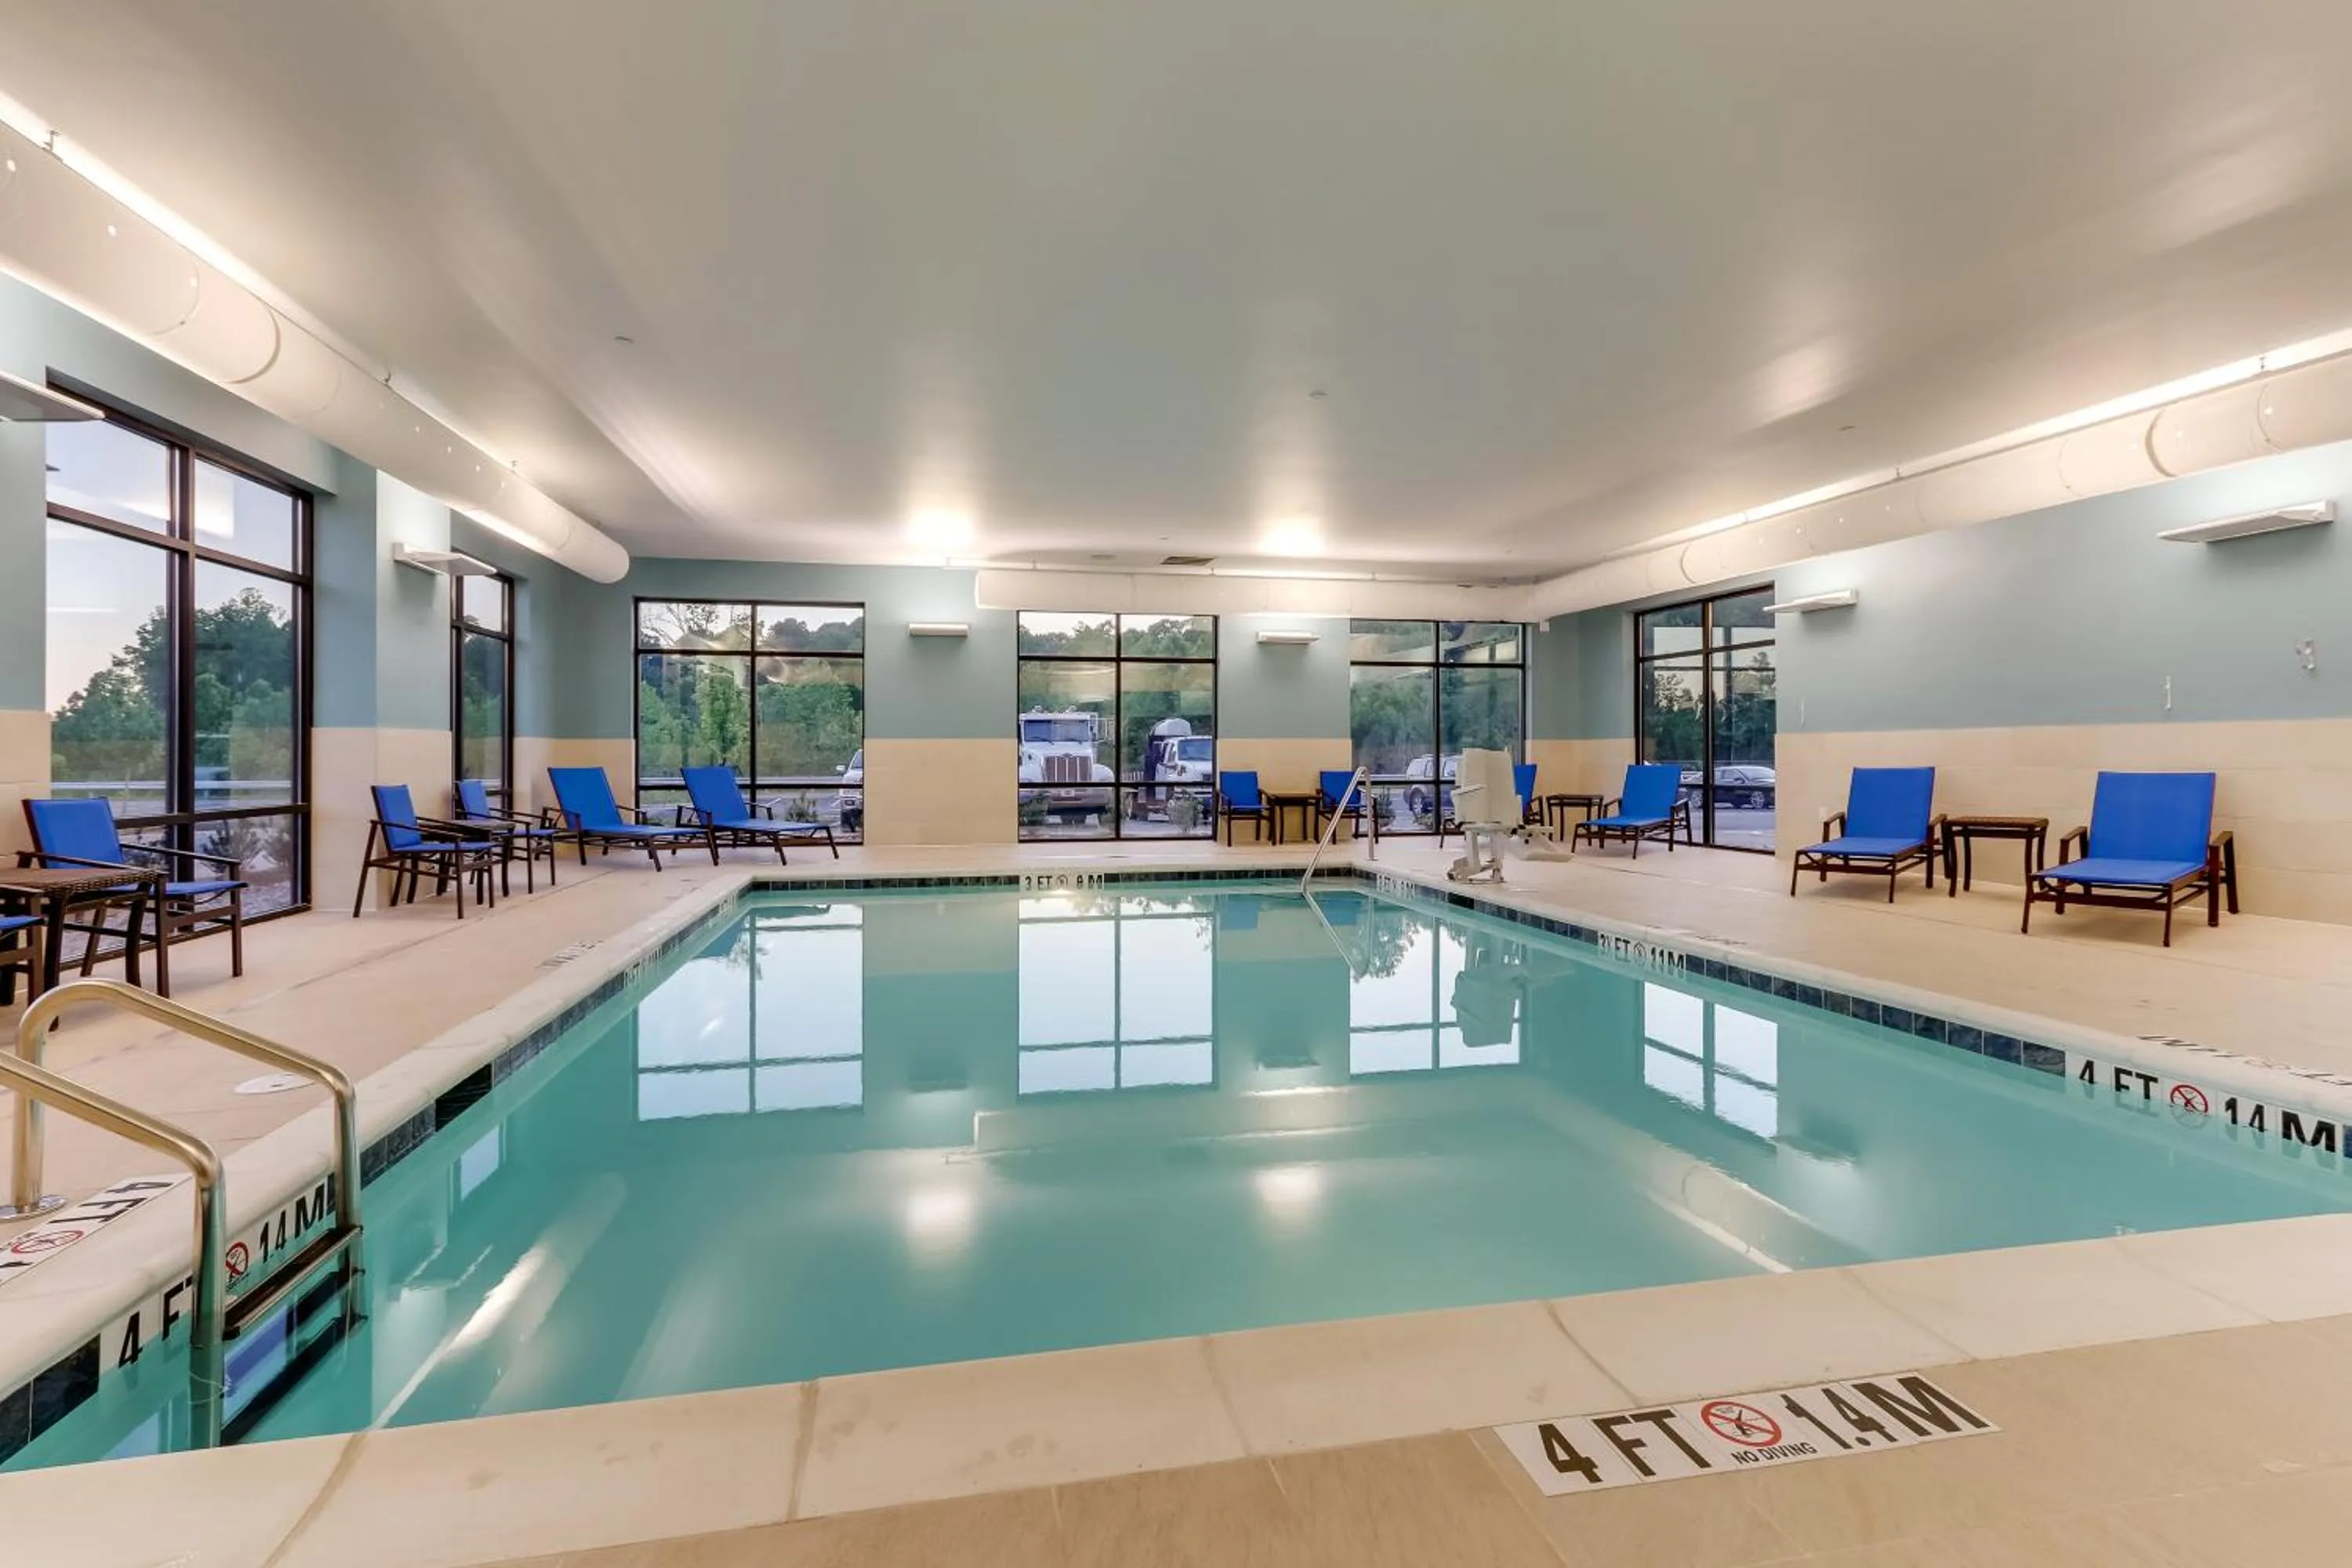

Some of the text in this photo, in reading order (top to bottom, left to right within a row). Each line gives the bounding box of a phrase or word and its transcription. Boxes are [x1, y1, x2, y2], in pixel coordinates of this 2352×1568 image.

[2078, 1059, 2096, 1084] 4
[2114, 1065, 2158, 1100] FT
[118, 1311, 143, 1369] 4
[1537, 1376, 1990, 1483] 4 FT 1.4M
[1730, 1442, 1818, 1465] NO DIVING
